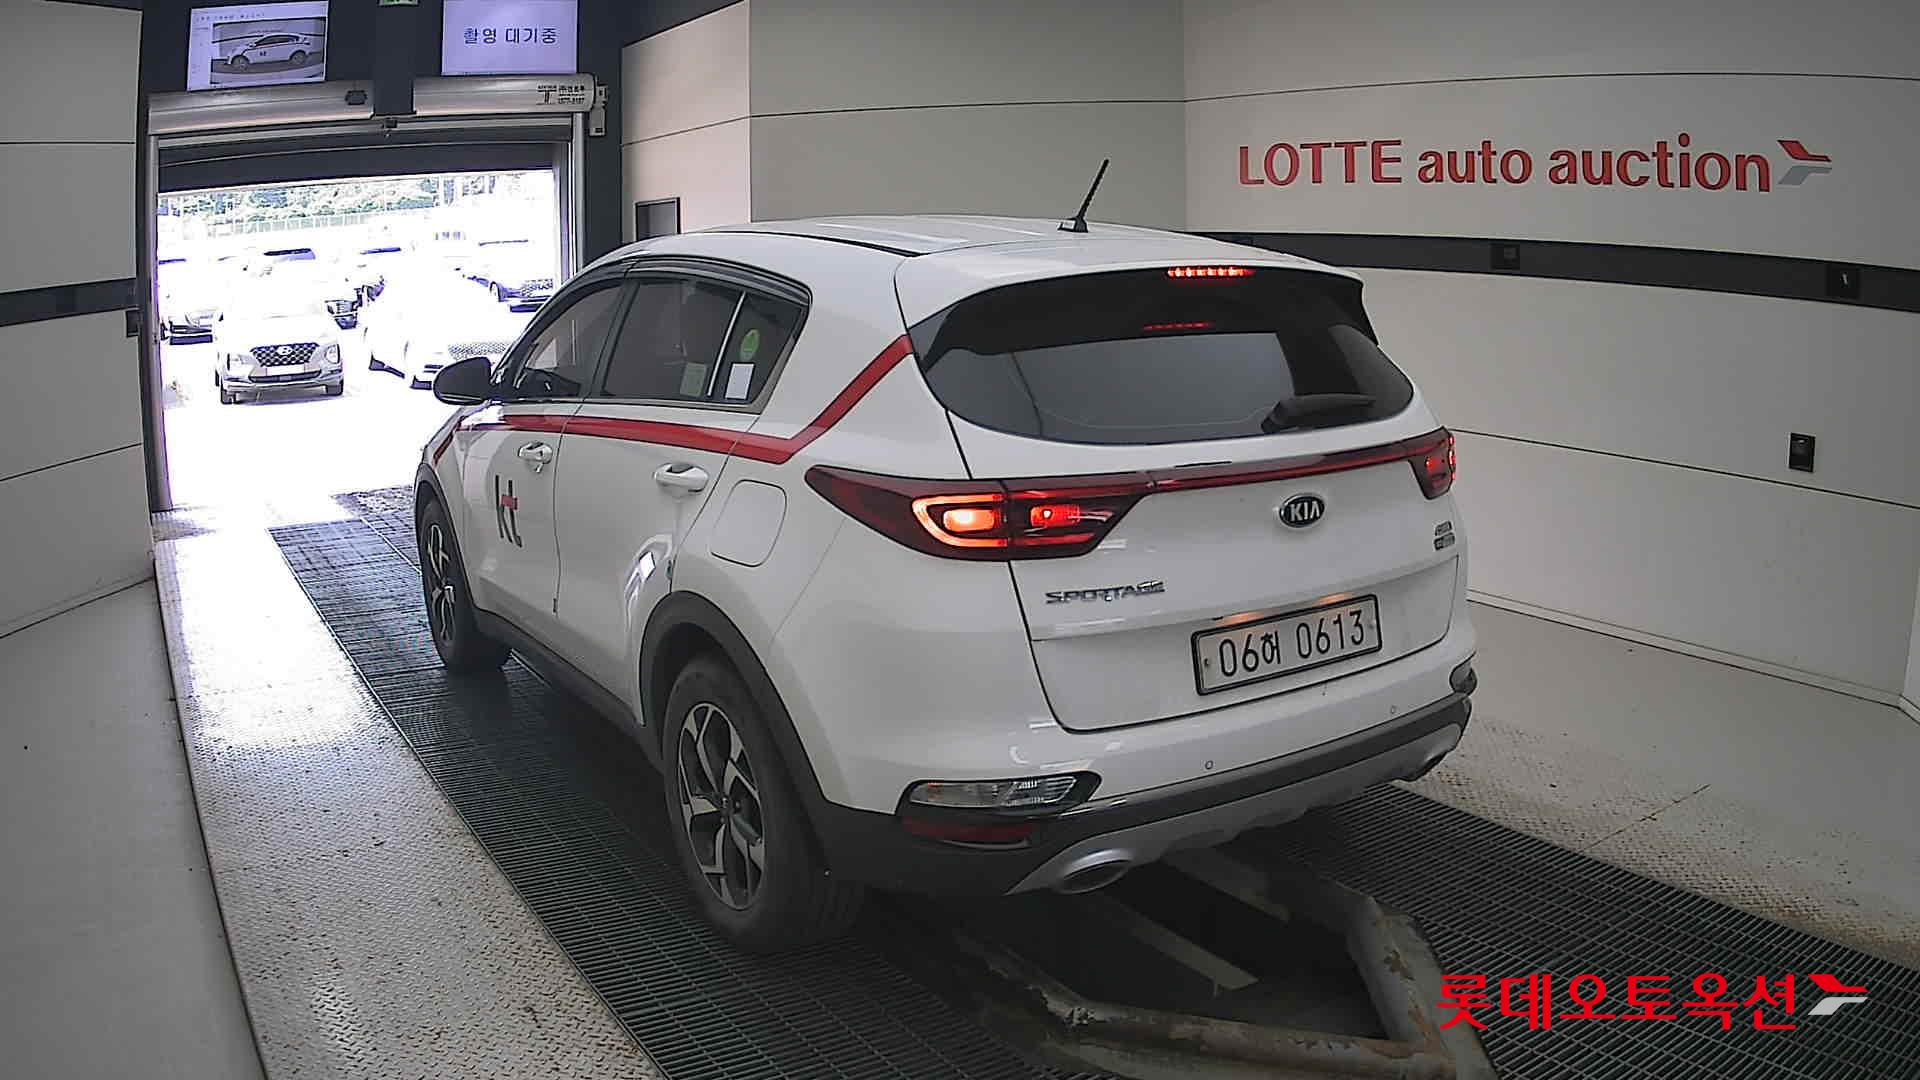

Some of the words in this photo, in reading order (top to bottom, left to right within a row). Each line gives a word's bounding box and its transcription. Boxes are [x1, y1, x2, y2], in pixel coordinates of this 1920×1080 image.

[505, 27, 558, 45] 대기중
[1239, 139, 1401, 186] LOTTE
[1417, 140, 1533, 184] auto
[1548, 132, 1771, 192] auction
[1289, 500, 1321, 522] KIA
[1045, 580, 1165, 604] SPORTAGE
[1218, 630, 1282, 678] 06허
[1295, 609, 1365, 659] 0613
